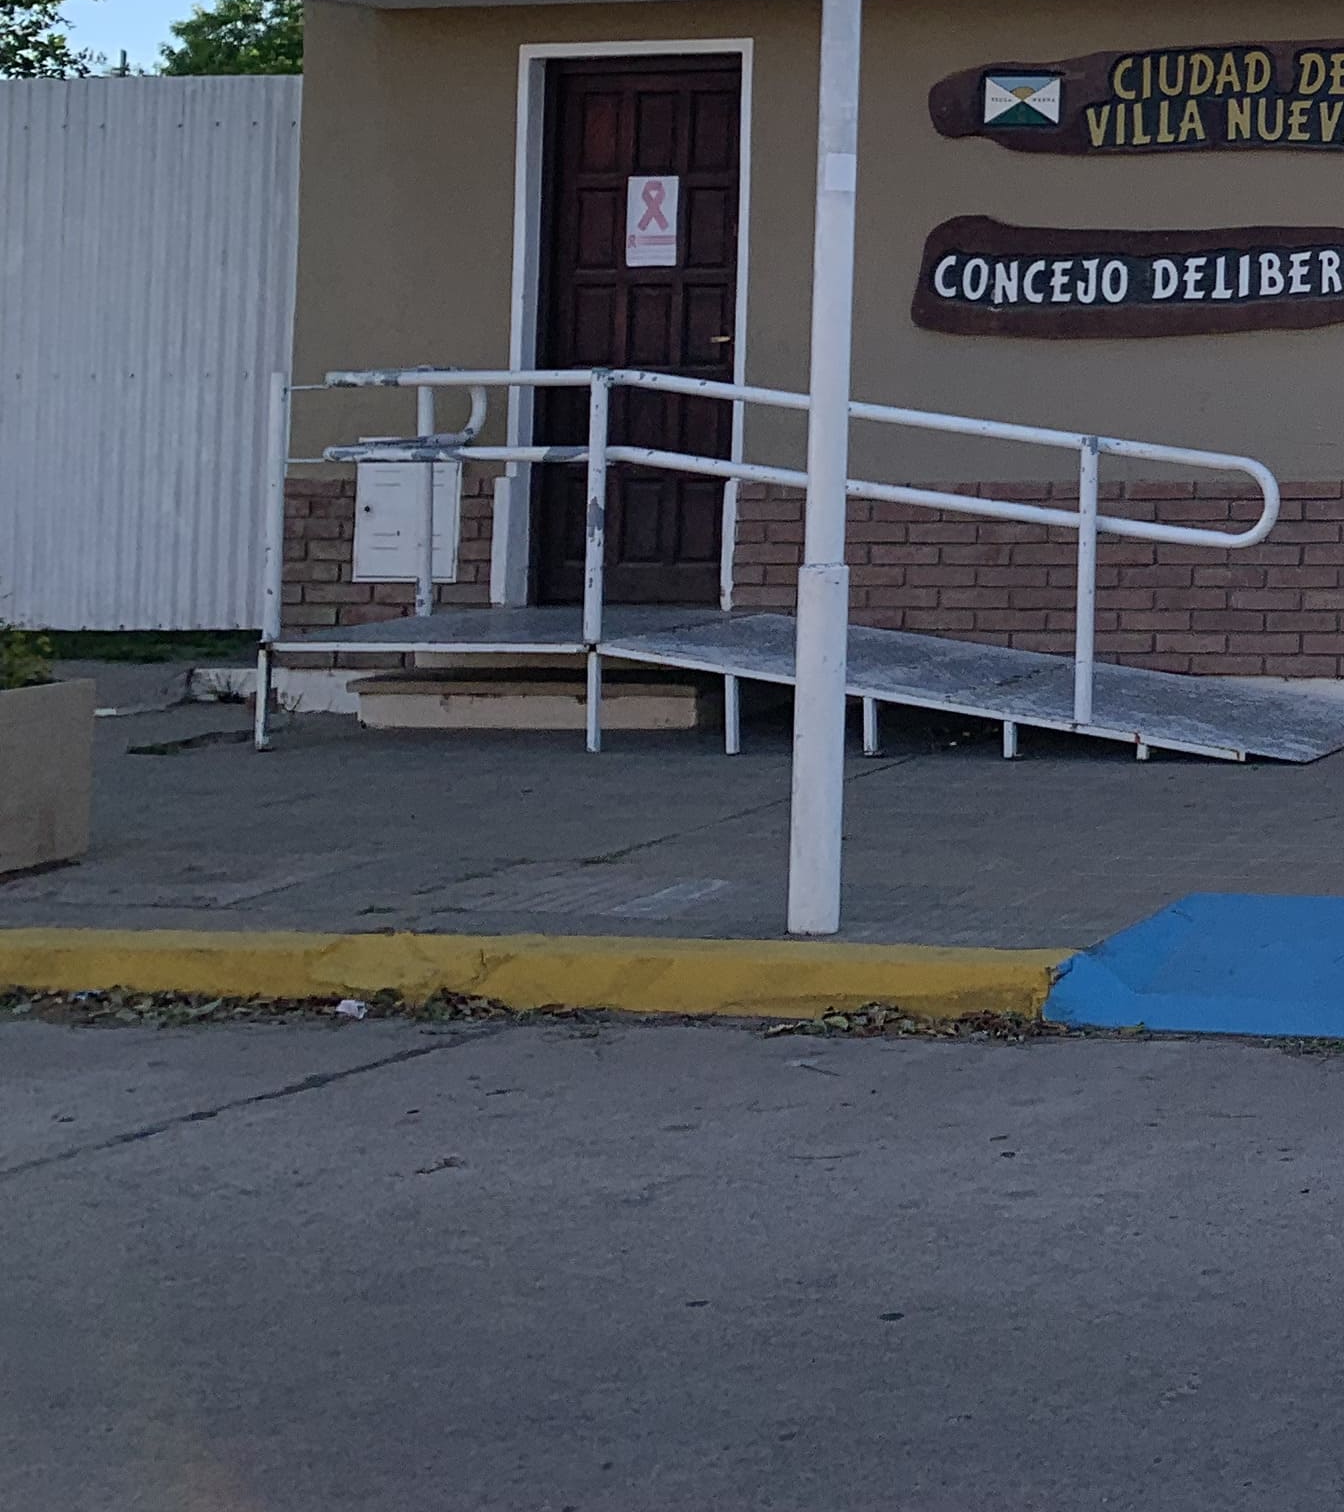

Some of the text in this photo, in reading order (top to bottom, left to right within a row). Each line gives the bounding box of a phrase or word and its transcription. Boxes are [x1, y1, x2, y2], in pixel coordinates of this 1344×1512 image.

[1113, 50, 1272, 100] CIUDAD
[1086, 98, 1206, 148] VILLA
[933, 254, 1129, 305] CONCEJO
